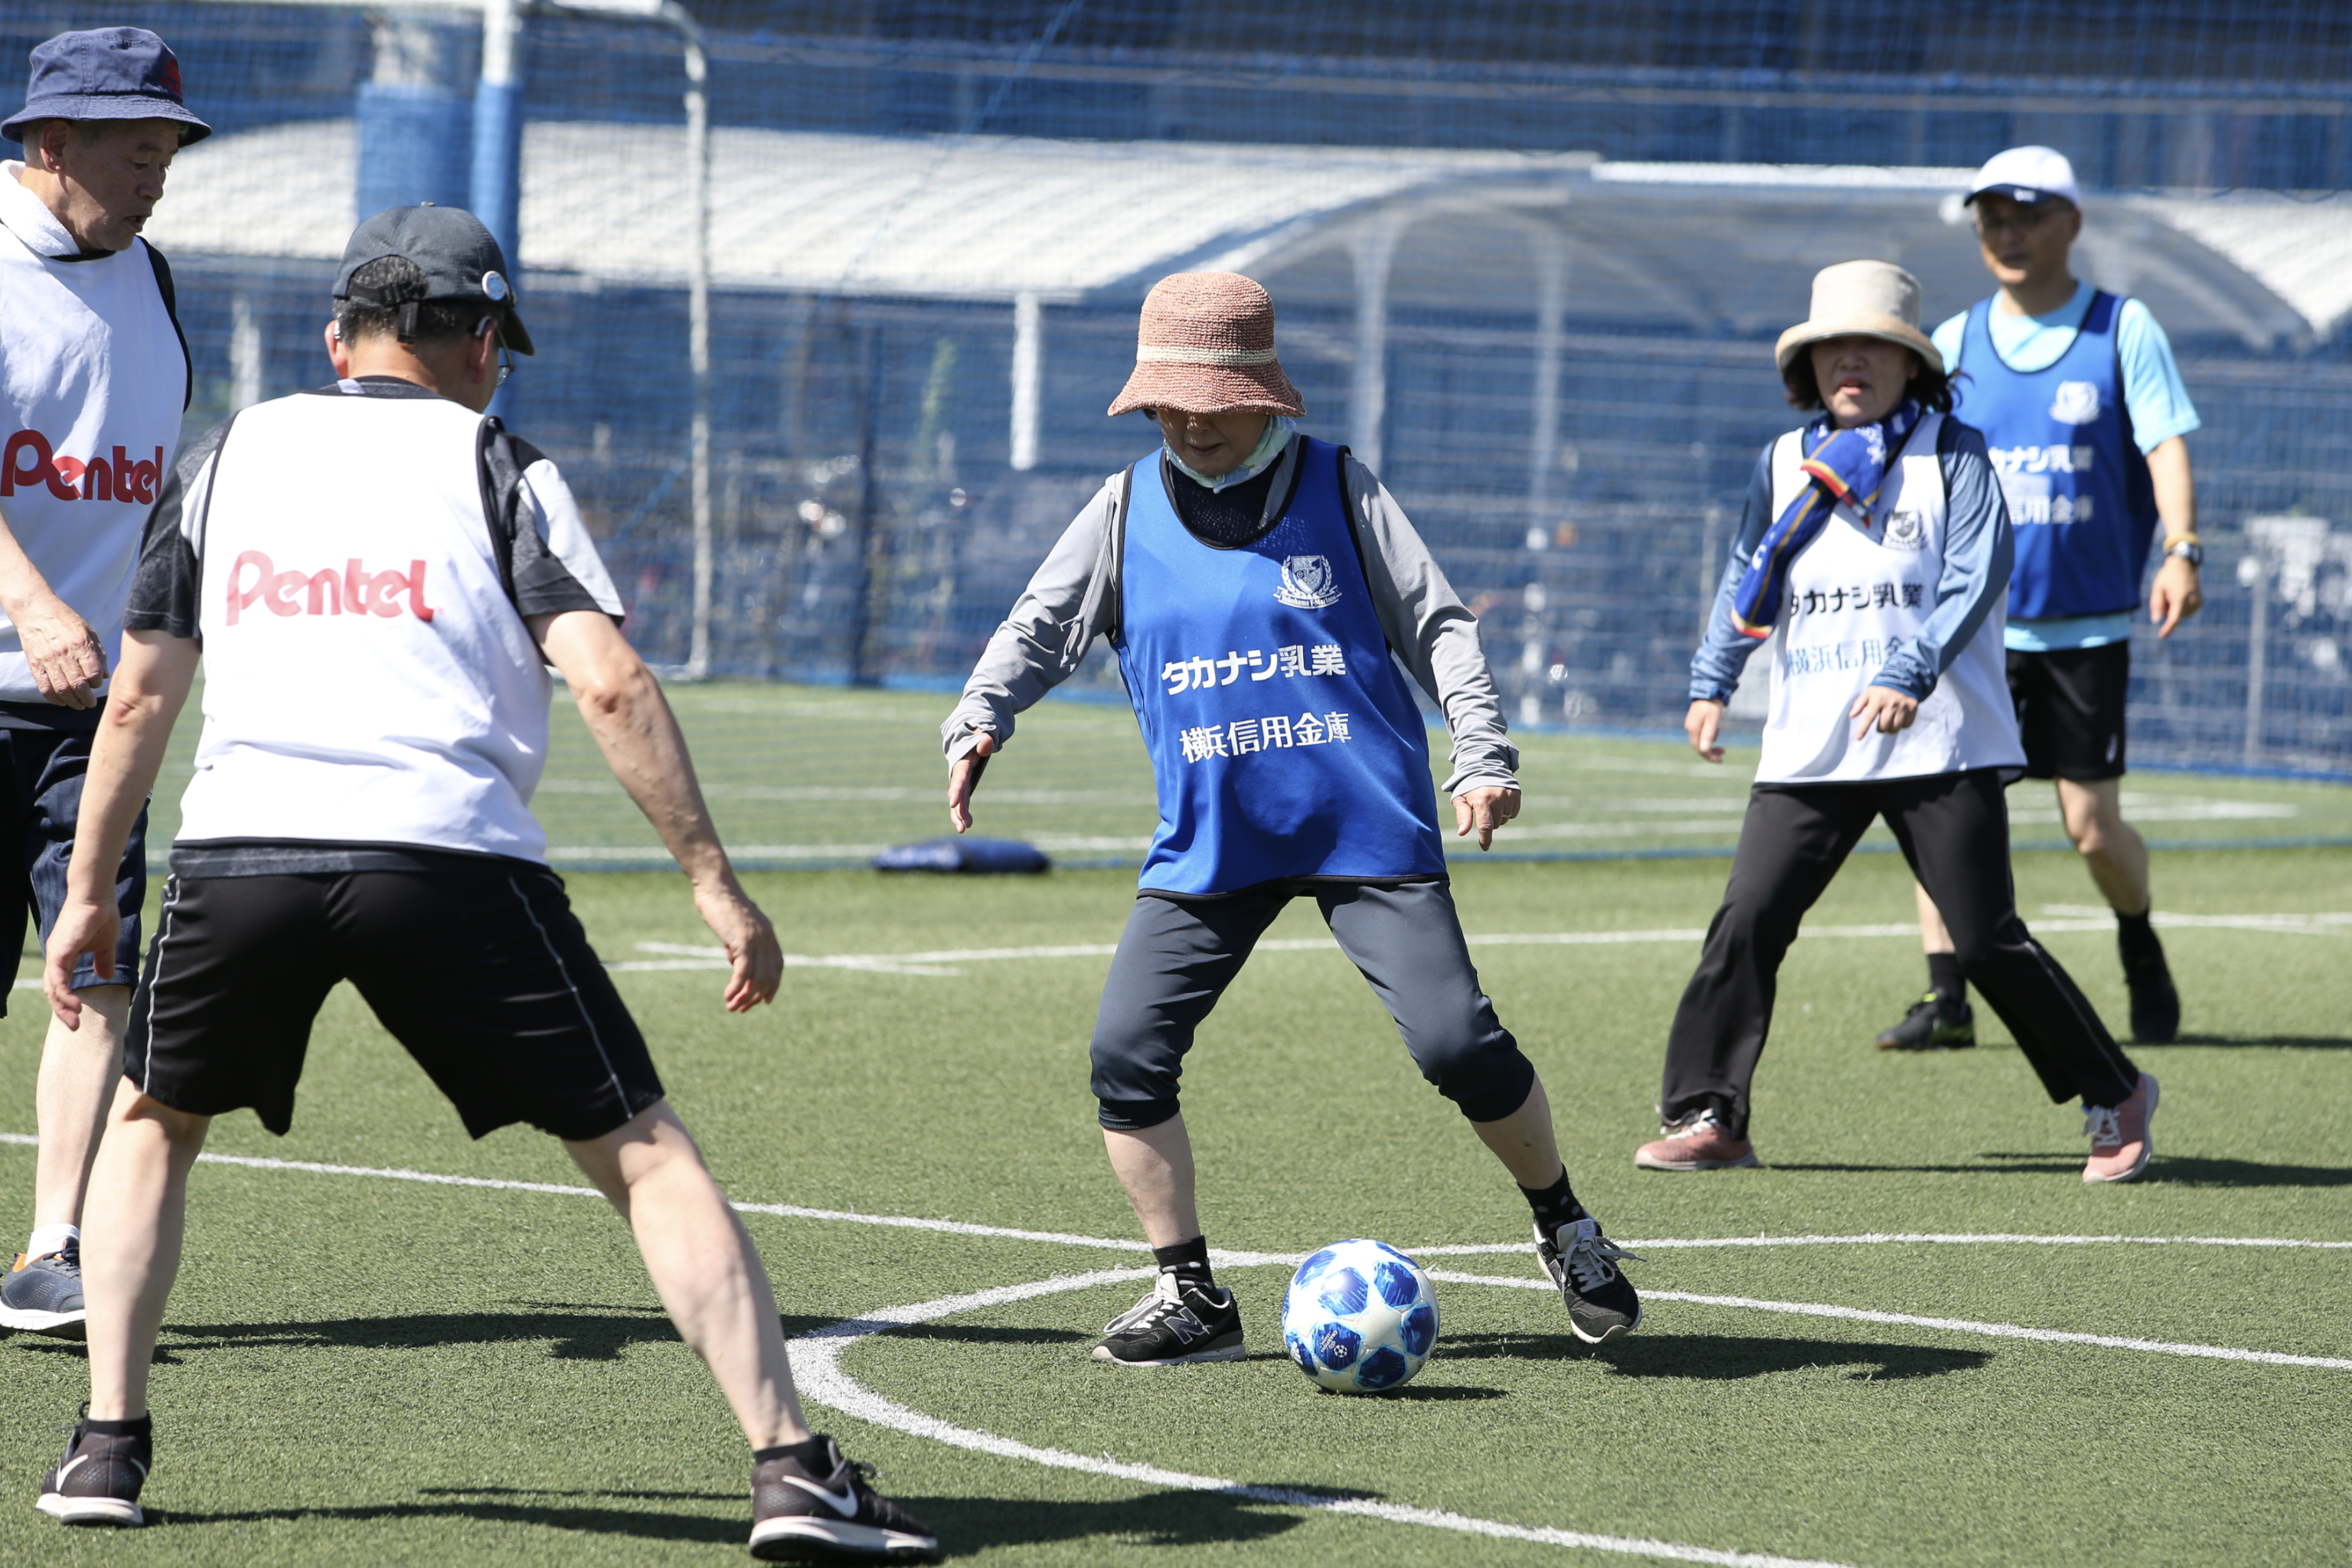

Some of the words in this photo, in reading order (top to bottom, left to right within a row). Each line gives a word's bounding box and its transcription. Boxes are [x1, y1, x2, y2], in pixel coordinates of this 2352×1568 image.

[1, 429, 163, 505] Pentel
[226, 550, 434, 626] Pentel
[1161, 645, 1346, 695] タカナシ乳業
[1179, 711, 1352, 763] 横浜信用金庫
[1321, 1330, 1338, 1353] CHAMPIONS
